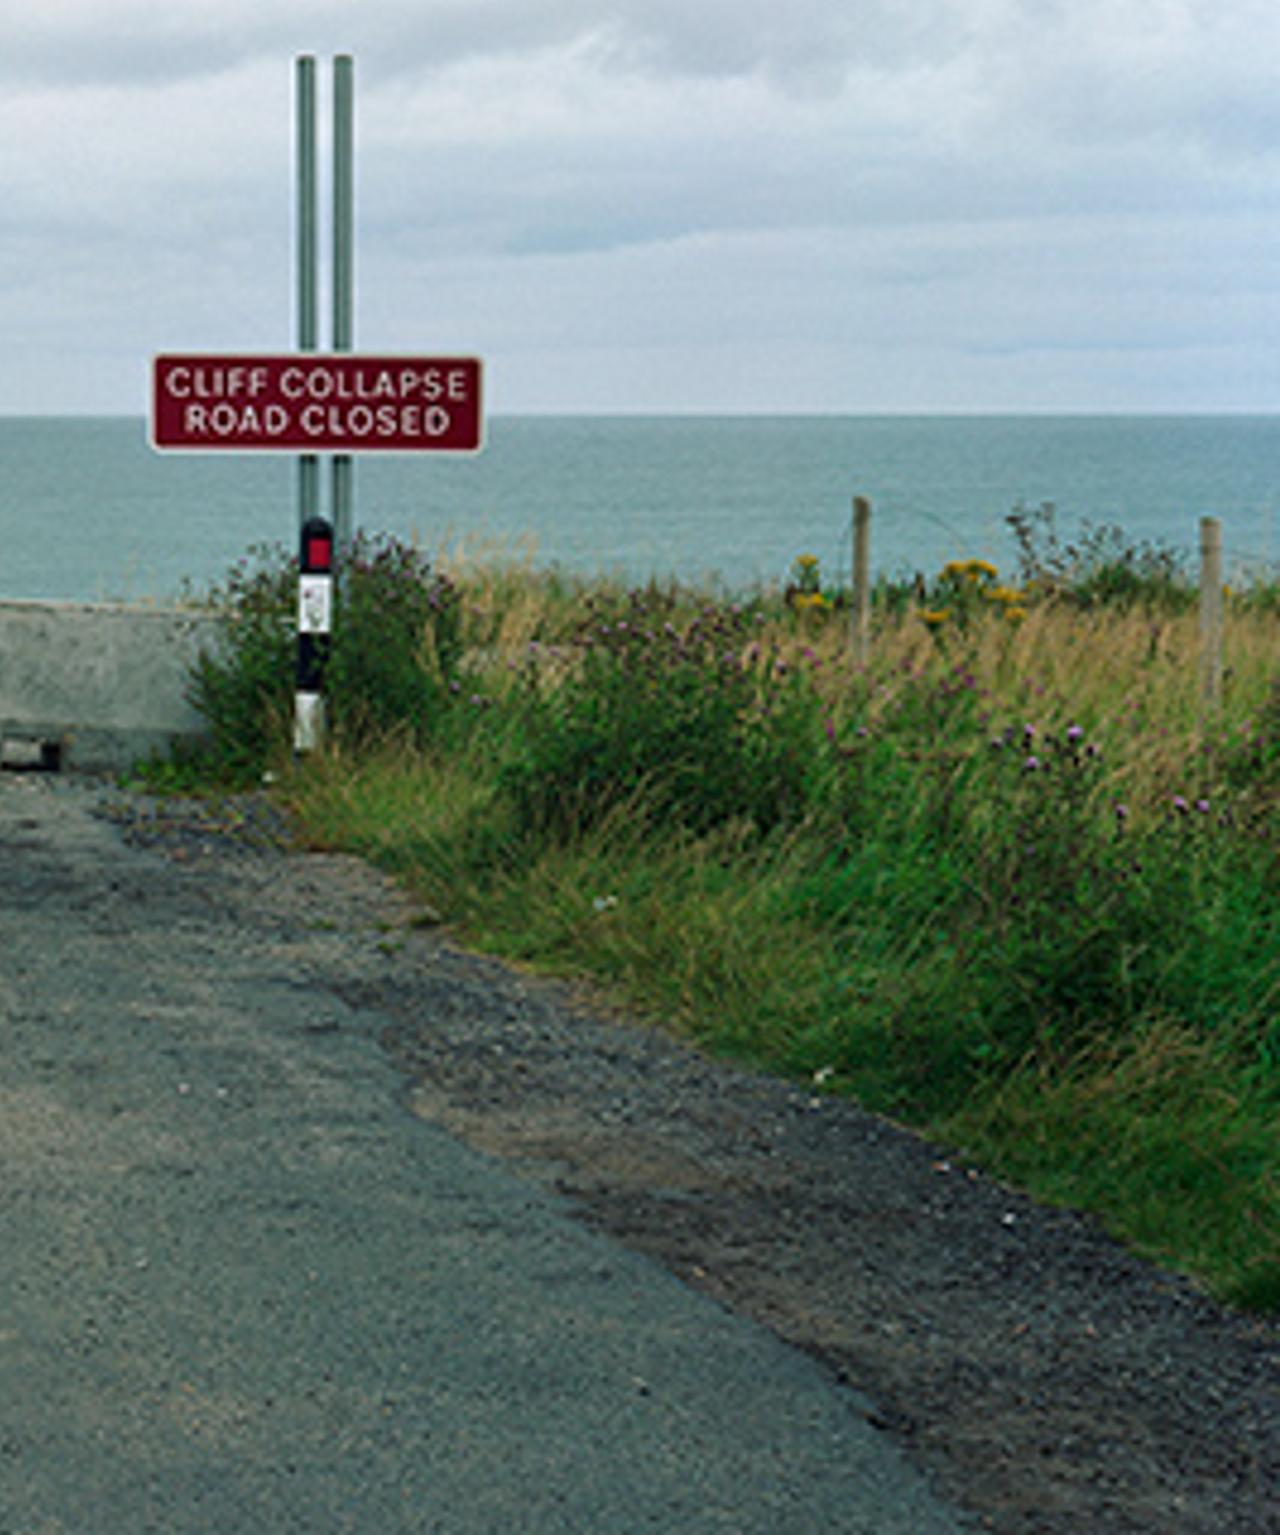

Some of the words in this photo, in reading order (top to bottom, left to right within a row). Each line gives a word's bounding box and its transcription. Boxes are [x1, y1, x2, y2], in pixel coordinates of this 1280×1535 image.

[166, 367, 268, 398] CLIFF
[279, 367, 467, 399] COLLAPSE
[185, 405, 288, 434] ROAD
[300, 405, 450, 435] CLOSED
